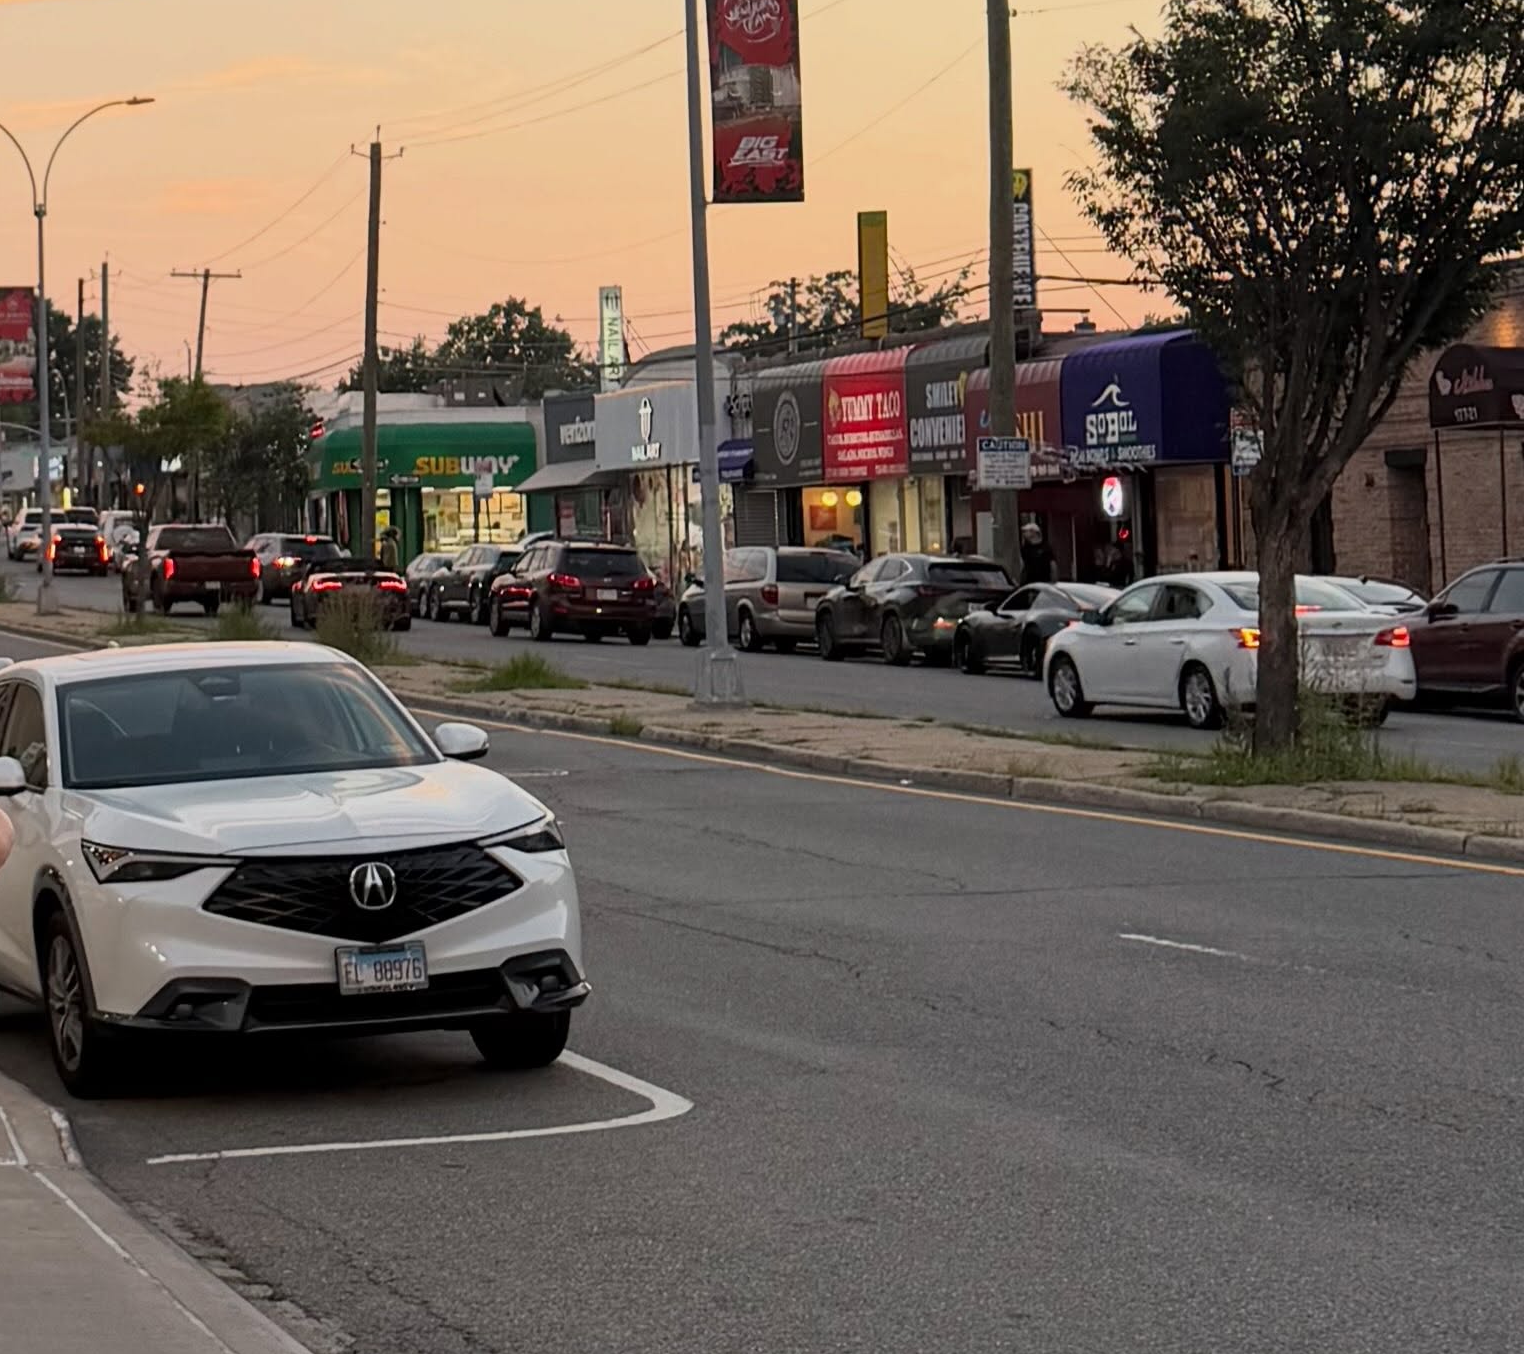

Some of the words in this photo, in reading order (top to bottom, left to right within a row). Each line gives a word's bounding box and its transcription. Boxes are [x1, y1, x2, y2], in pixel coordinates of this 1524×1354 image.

[732, 148, 789, 161] EAST
[741, 136, 778, 149] BIG
[607, 316, 620, 350] NAIL
[841, 394, 874, 423] YUMMY
[876, 390, 901, 420] TACO
[560, 416, 595, 446] verizon
